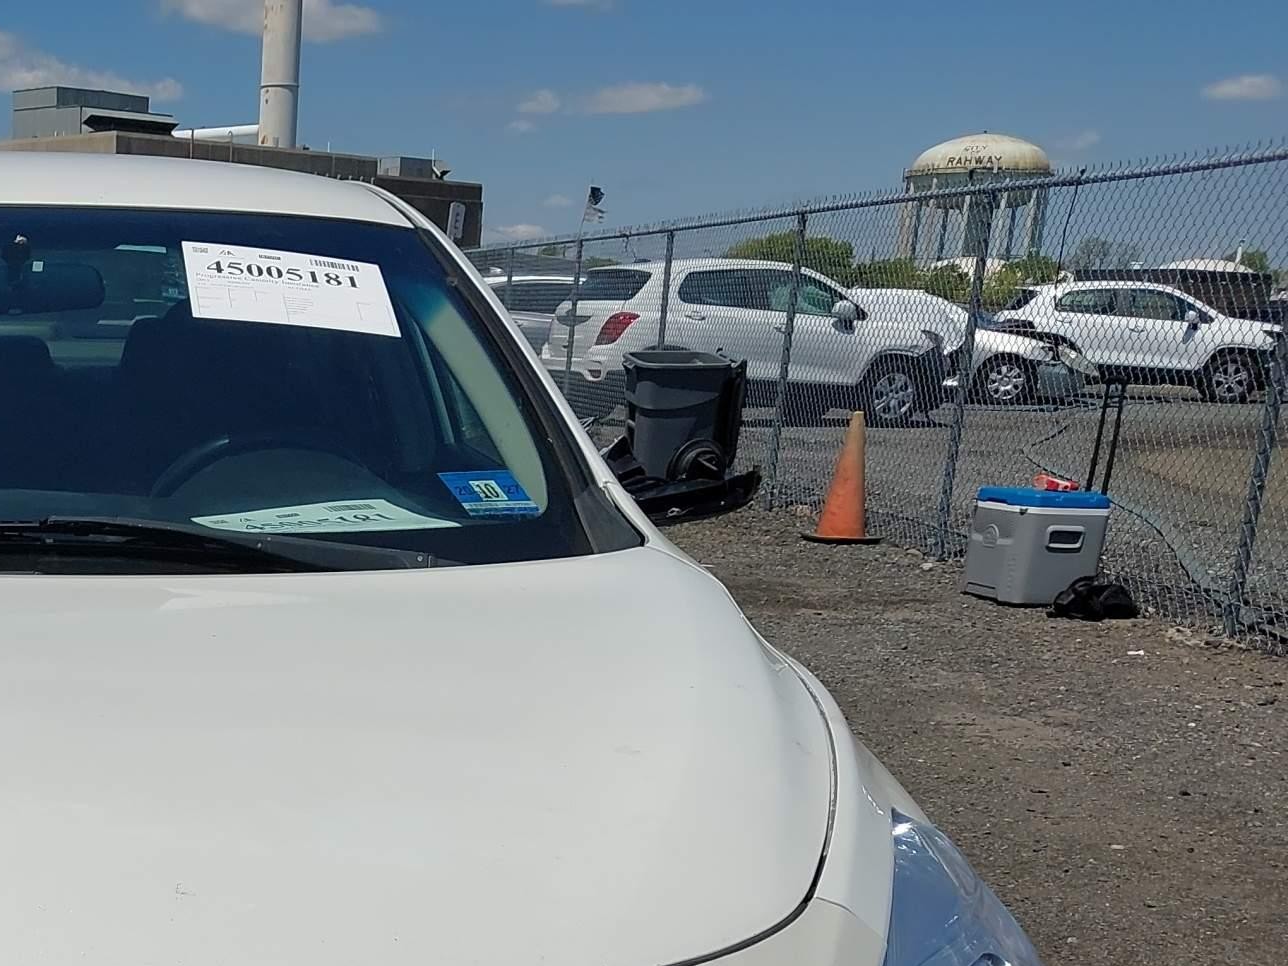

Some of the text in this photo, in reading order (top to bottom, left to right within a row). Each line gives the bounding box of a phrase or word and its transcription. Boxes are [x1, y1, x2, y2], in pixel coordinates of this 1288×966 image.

[946, 155, 1003, 167] RAHWAY
[205, 259, 361, 290] 45005181
[476, 482, 500, 499] 10
